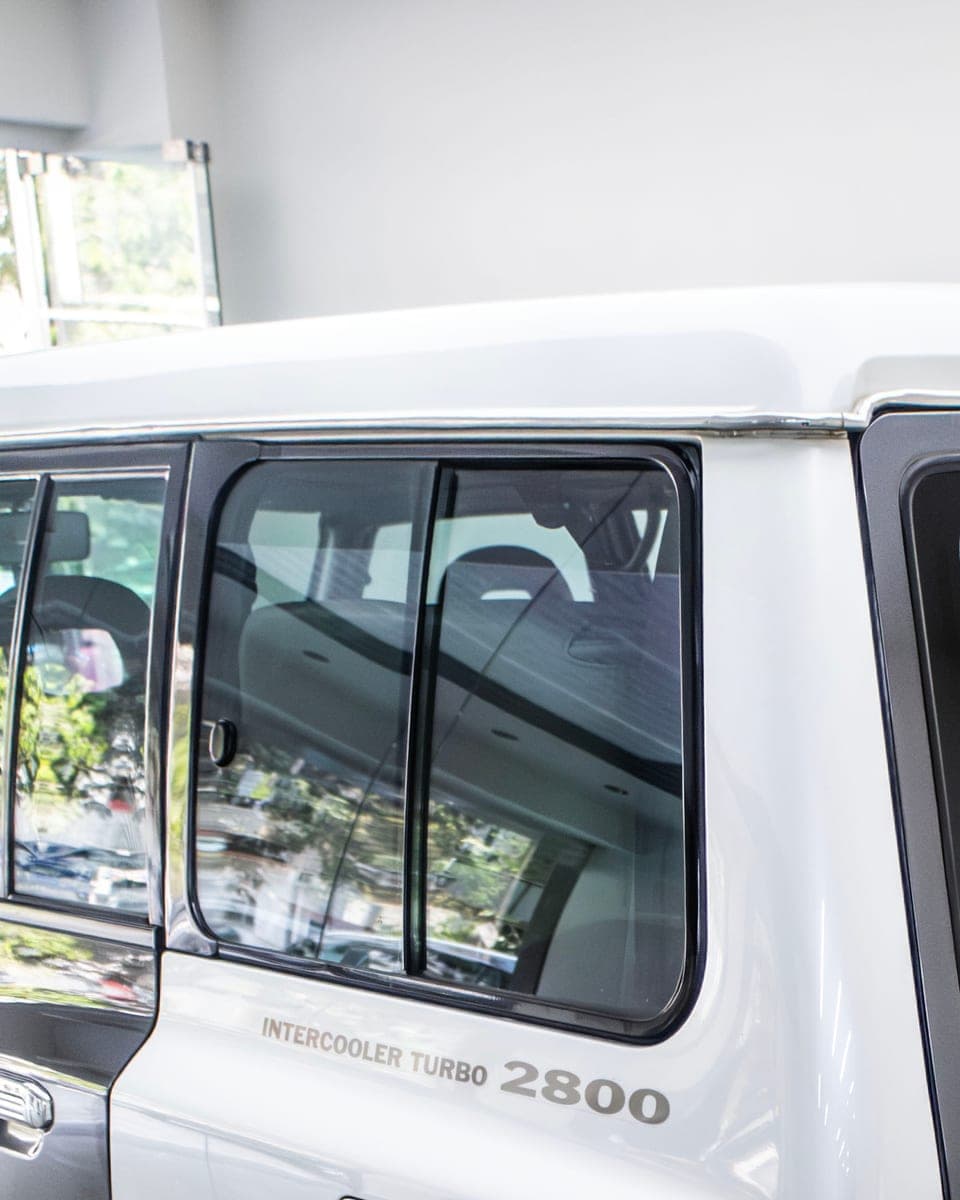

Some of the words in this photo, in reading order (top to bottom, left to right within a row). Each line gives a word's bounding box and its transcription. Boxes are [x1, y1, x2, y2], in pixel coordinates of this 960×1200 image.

[261, 1017, 402, 1068] INTERCOOLER
[410, 1051, 488, 1086] TURBO
[500, 1060, 671, 1125] 2800
